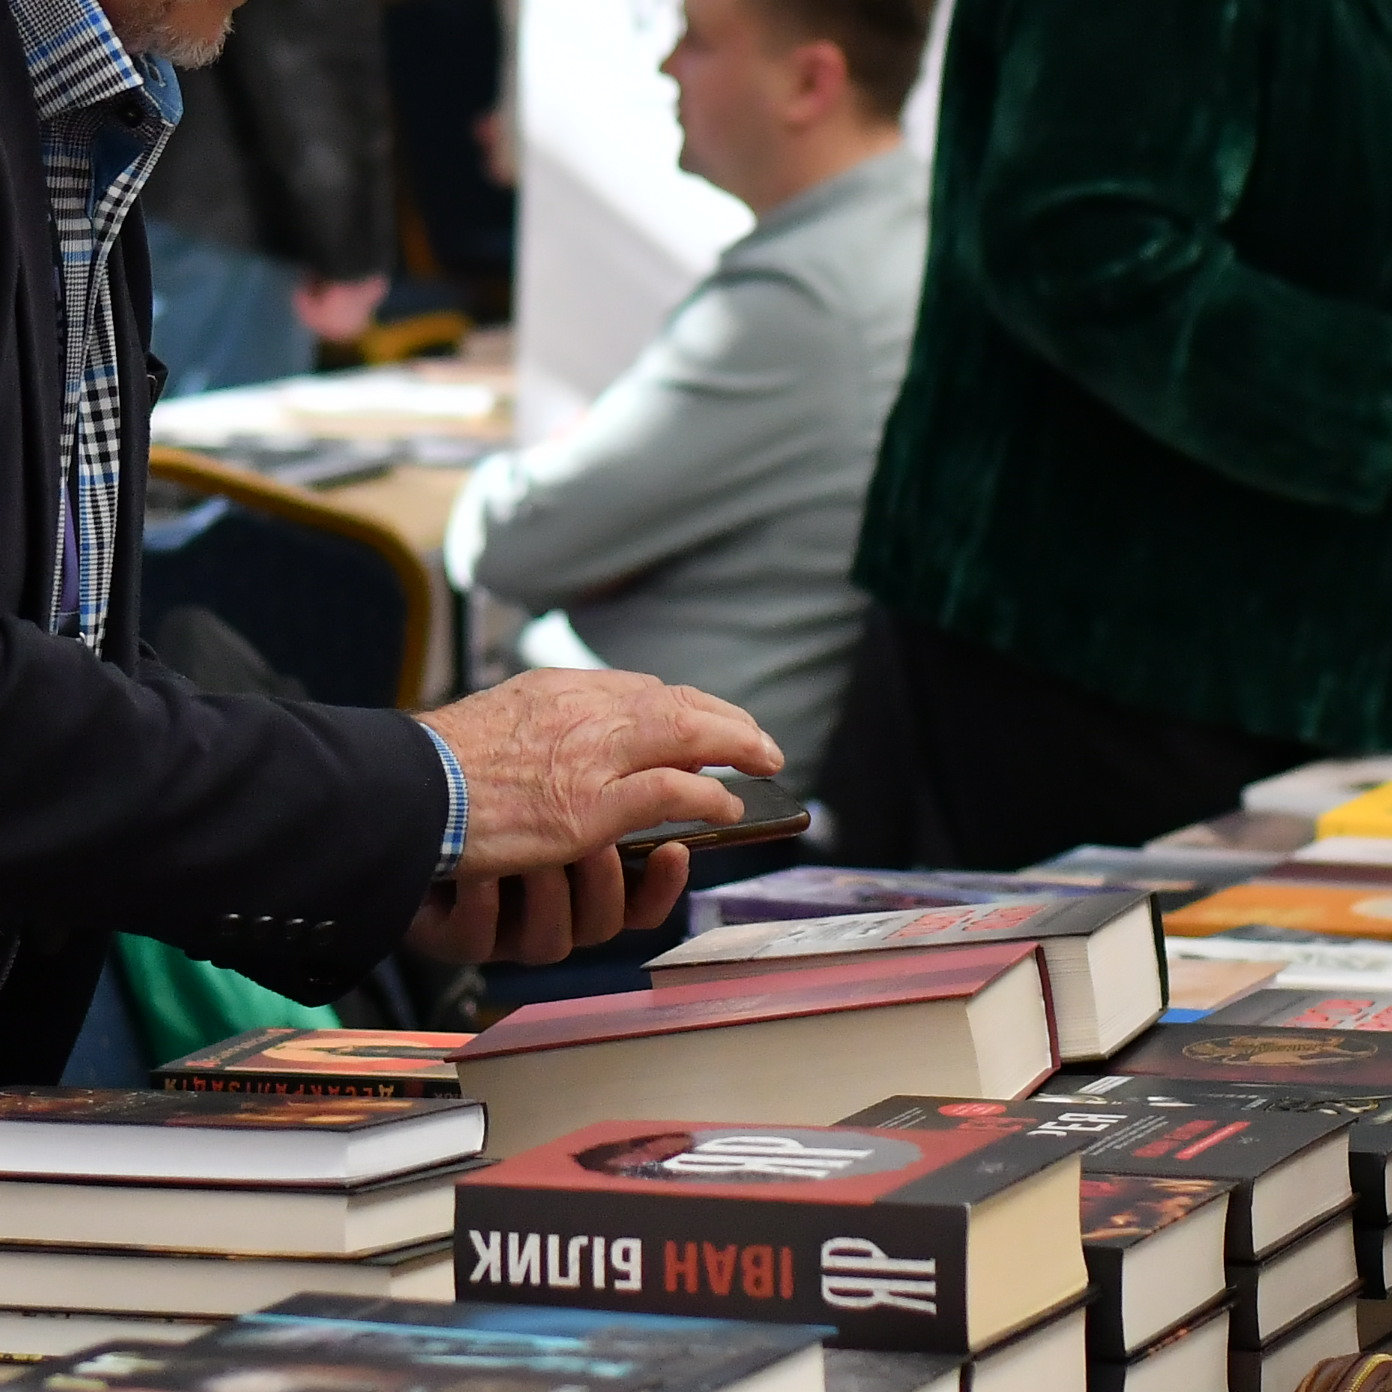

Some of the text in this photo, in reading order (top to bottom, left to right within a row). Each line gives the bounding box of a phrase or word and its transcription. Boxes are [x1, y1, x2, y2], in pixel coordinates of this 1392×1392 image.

[663, 1135, 875, 1178] ЯР
[469, 1229, 795, 1300] ІВАН БІЛИК
[820, 1236, 937, 1316] ЯР
